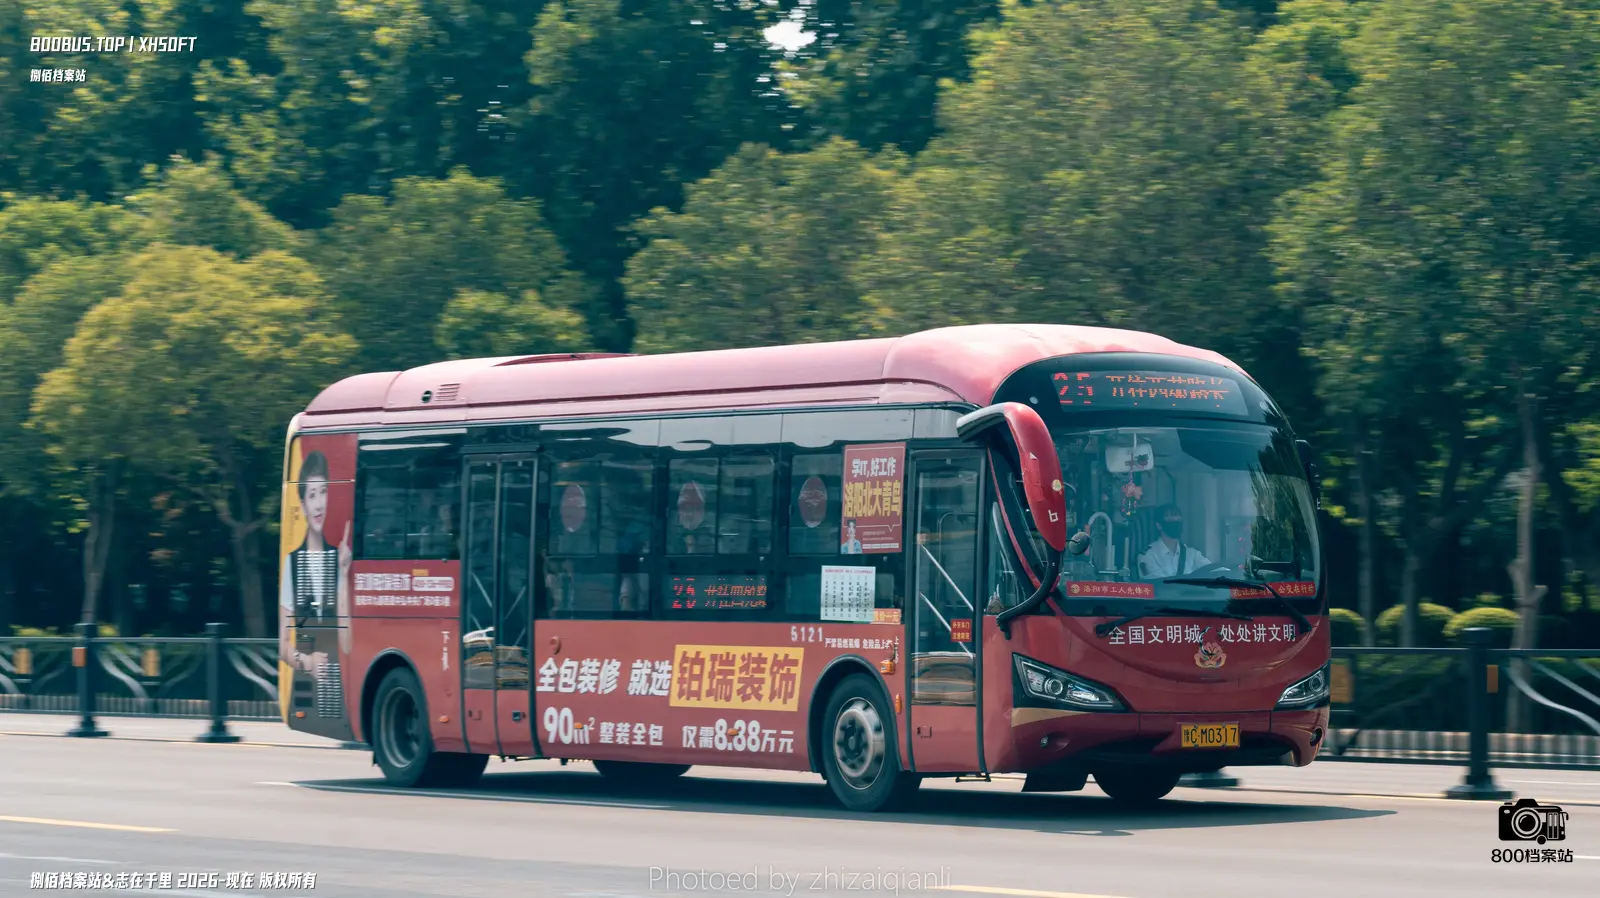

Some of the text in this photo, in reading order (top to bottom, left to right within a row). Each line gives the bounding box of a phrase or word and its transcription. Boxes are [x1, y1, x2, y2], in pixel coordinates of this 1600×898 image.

[844, 480, 901, 517] 洛阳北大青鸟
[1108, 624, 1296, 645] 全国文明城 处处讲文明
[536, 651, 799, 705] 全包装修 就选 铂瑞装饰
[599, 722, 663, 747] 整装全包
